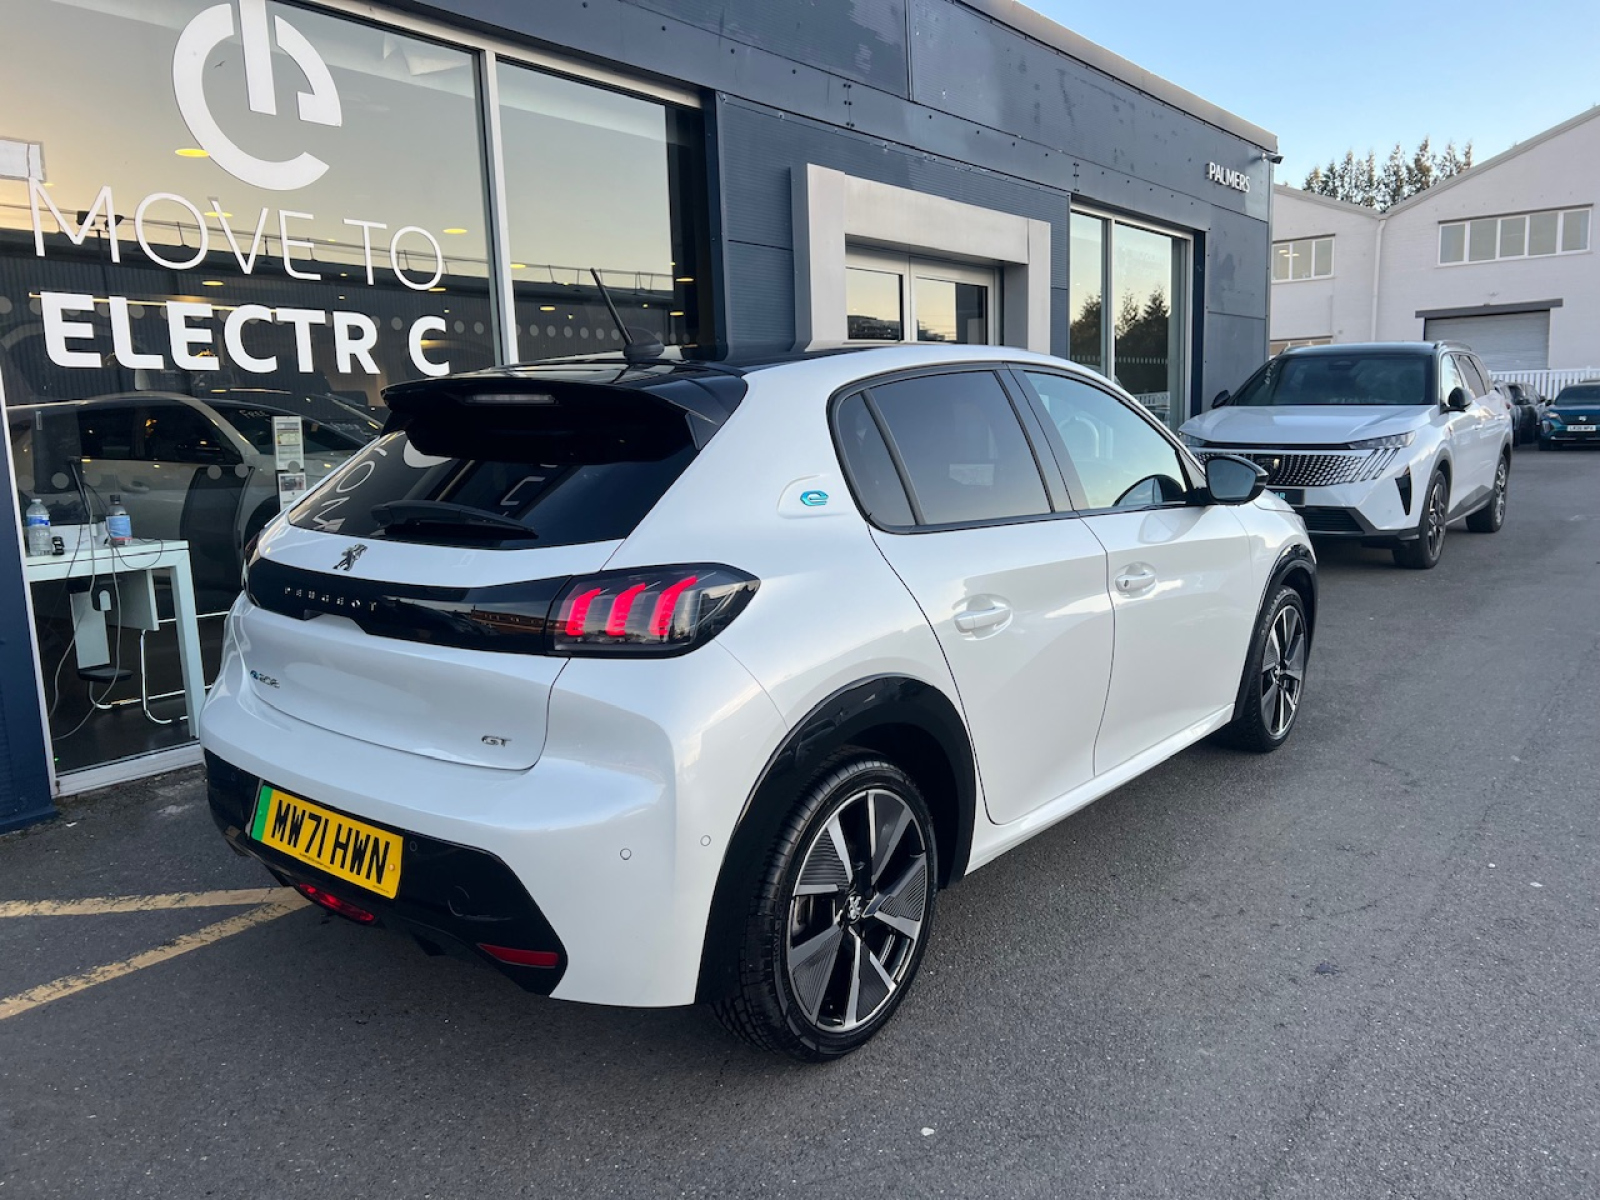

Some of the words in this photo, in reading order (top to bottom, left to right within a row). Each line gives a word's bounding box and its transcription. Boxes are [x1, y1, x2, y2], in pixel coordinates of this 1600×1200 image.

[1209, 161, 1250, 193] PALMERS
[30, 178, 322, 281] MOVE
[343, 218, 444, 291] TO
[284, 586, 377, 612] PEUGEOT
[481, 735, 512, 748] GT
[271, 799, 330, 859] MW71
[329, 822, 391, 885] HWN
